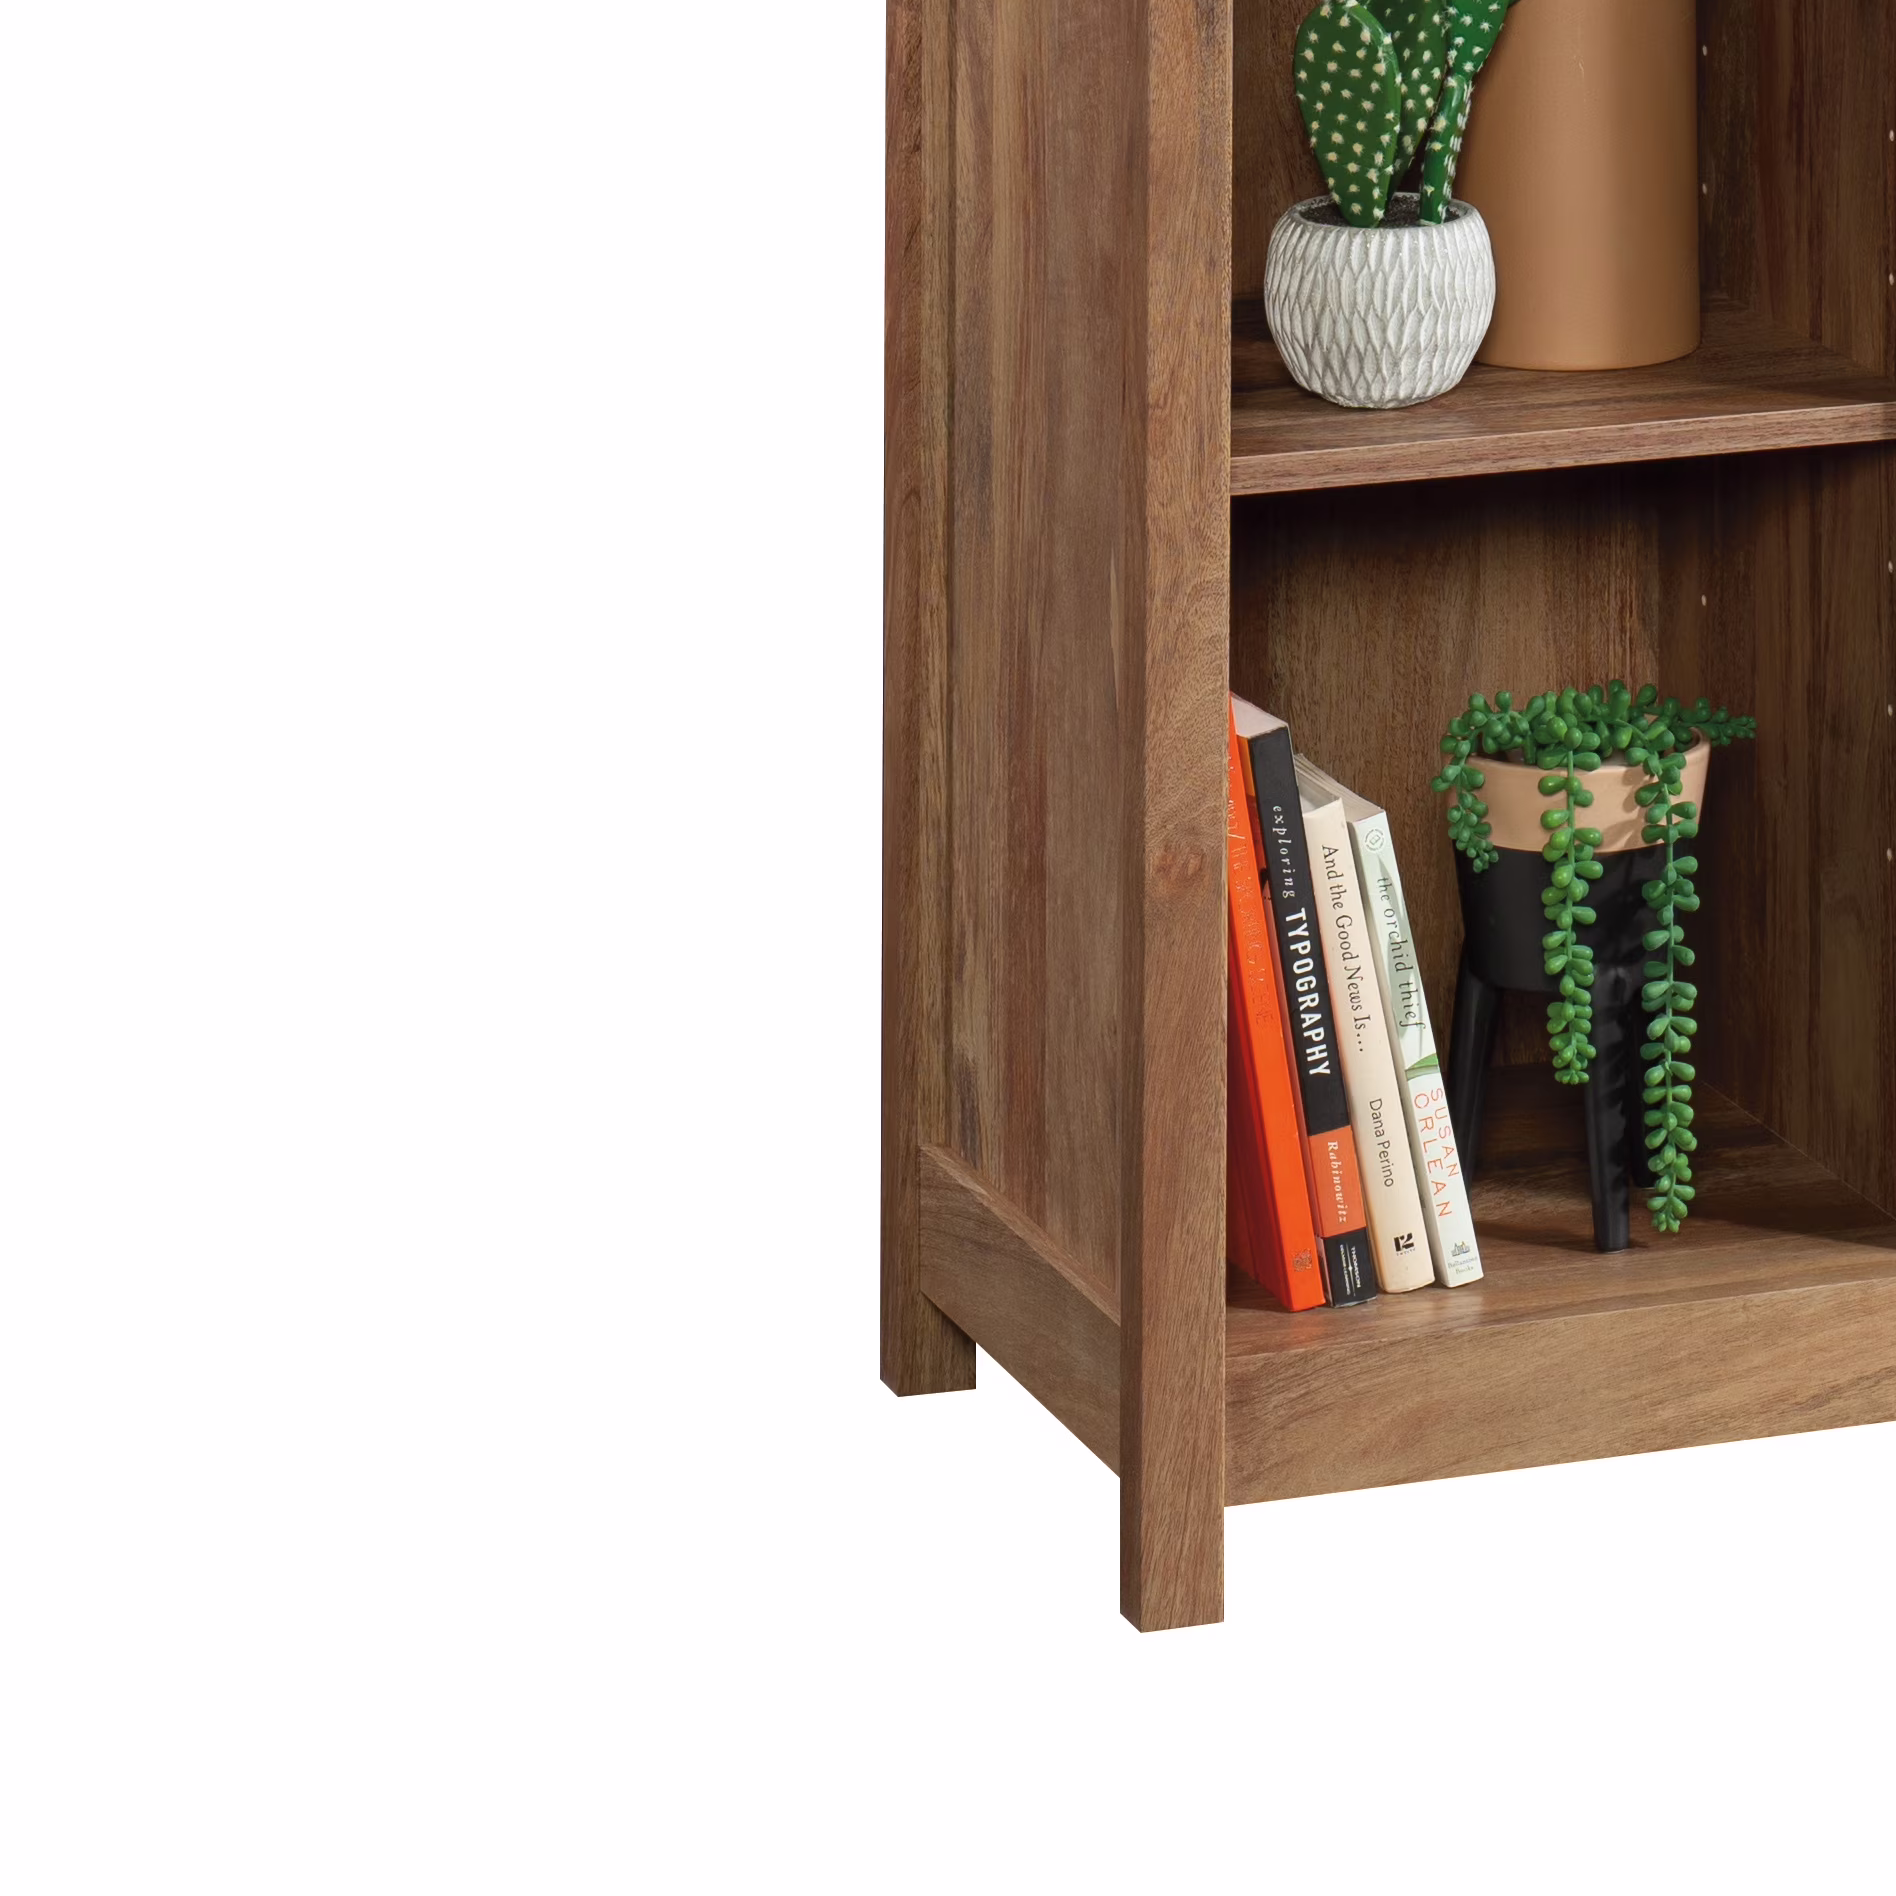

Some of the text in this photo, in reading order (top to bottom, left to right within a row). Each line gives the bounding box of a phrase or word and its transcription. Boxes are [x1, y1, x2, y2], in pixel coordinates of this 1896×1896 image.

[1273, 806, 1331, 1075] exploring TYPOGRAPHY
[1322, 845, 1371, 1052] And the Good News Is...
[1377, 876, 1426, 1029] the orchid thief
[1327, 1141, 1348, 1223] Rabinowitz
[1369, 1098, 1394, 1187] Dana Perino
[1414, 1093, 1453, 1217] ORLEAN
[1430, 1087, 1460, 1177] SUSAN
